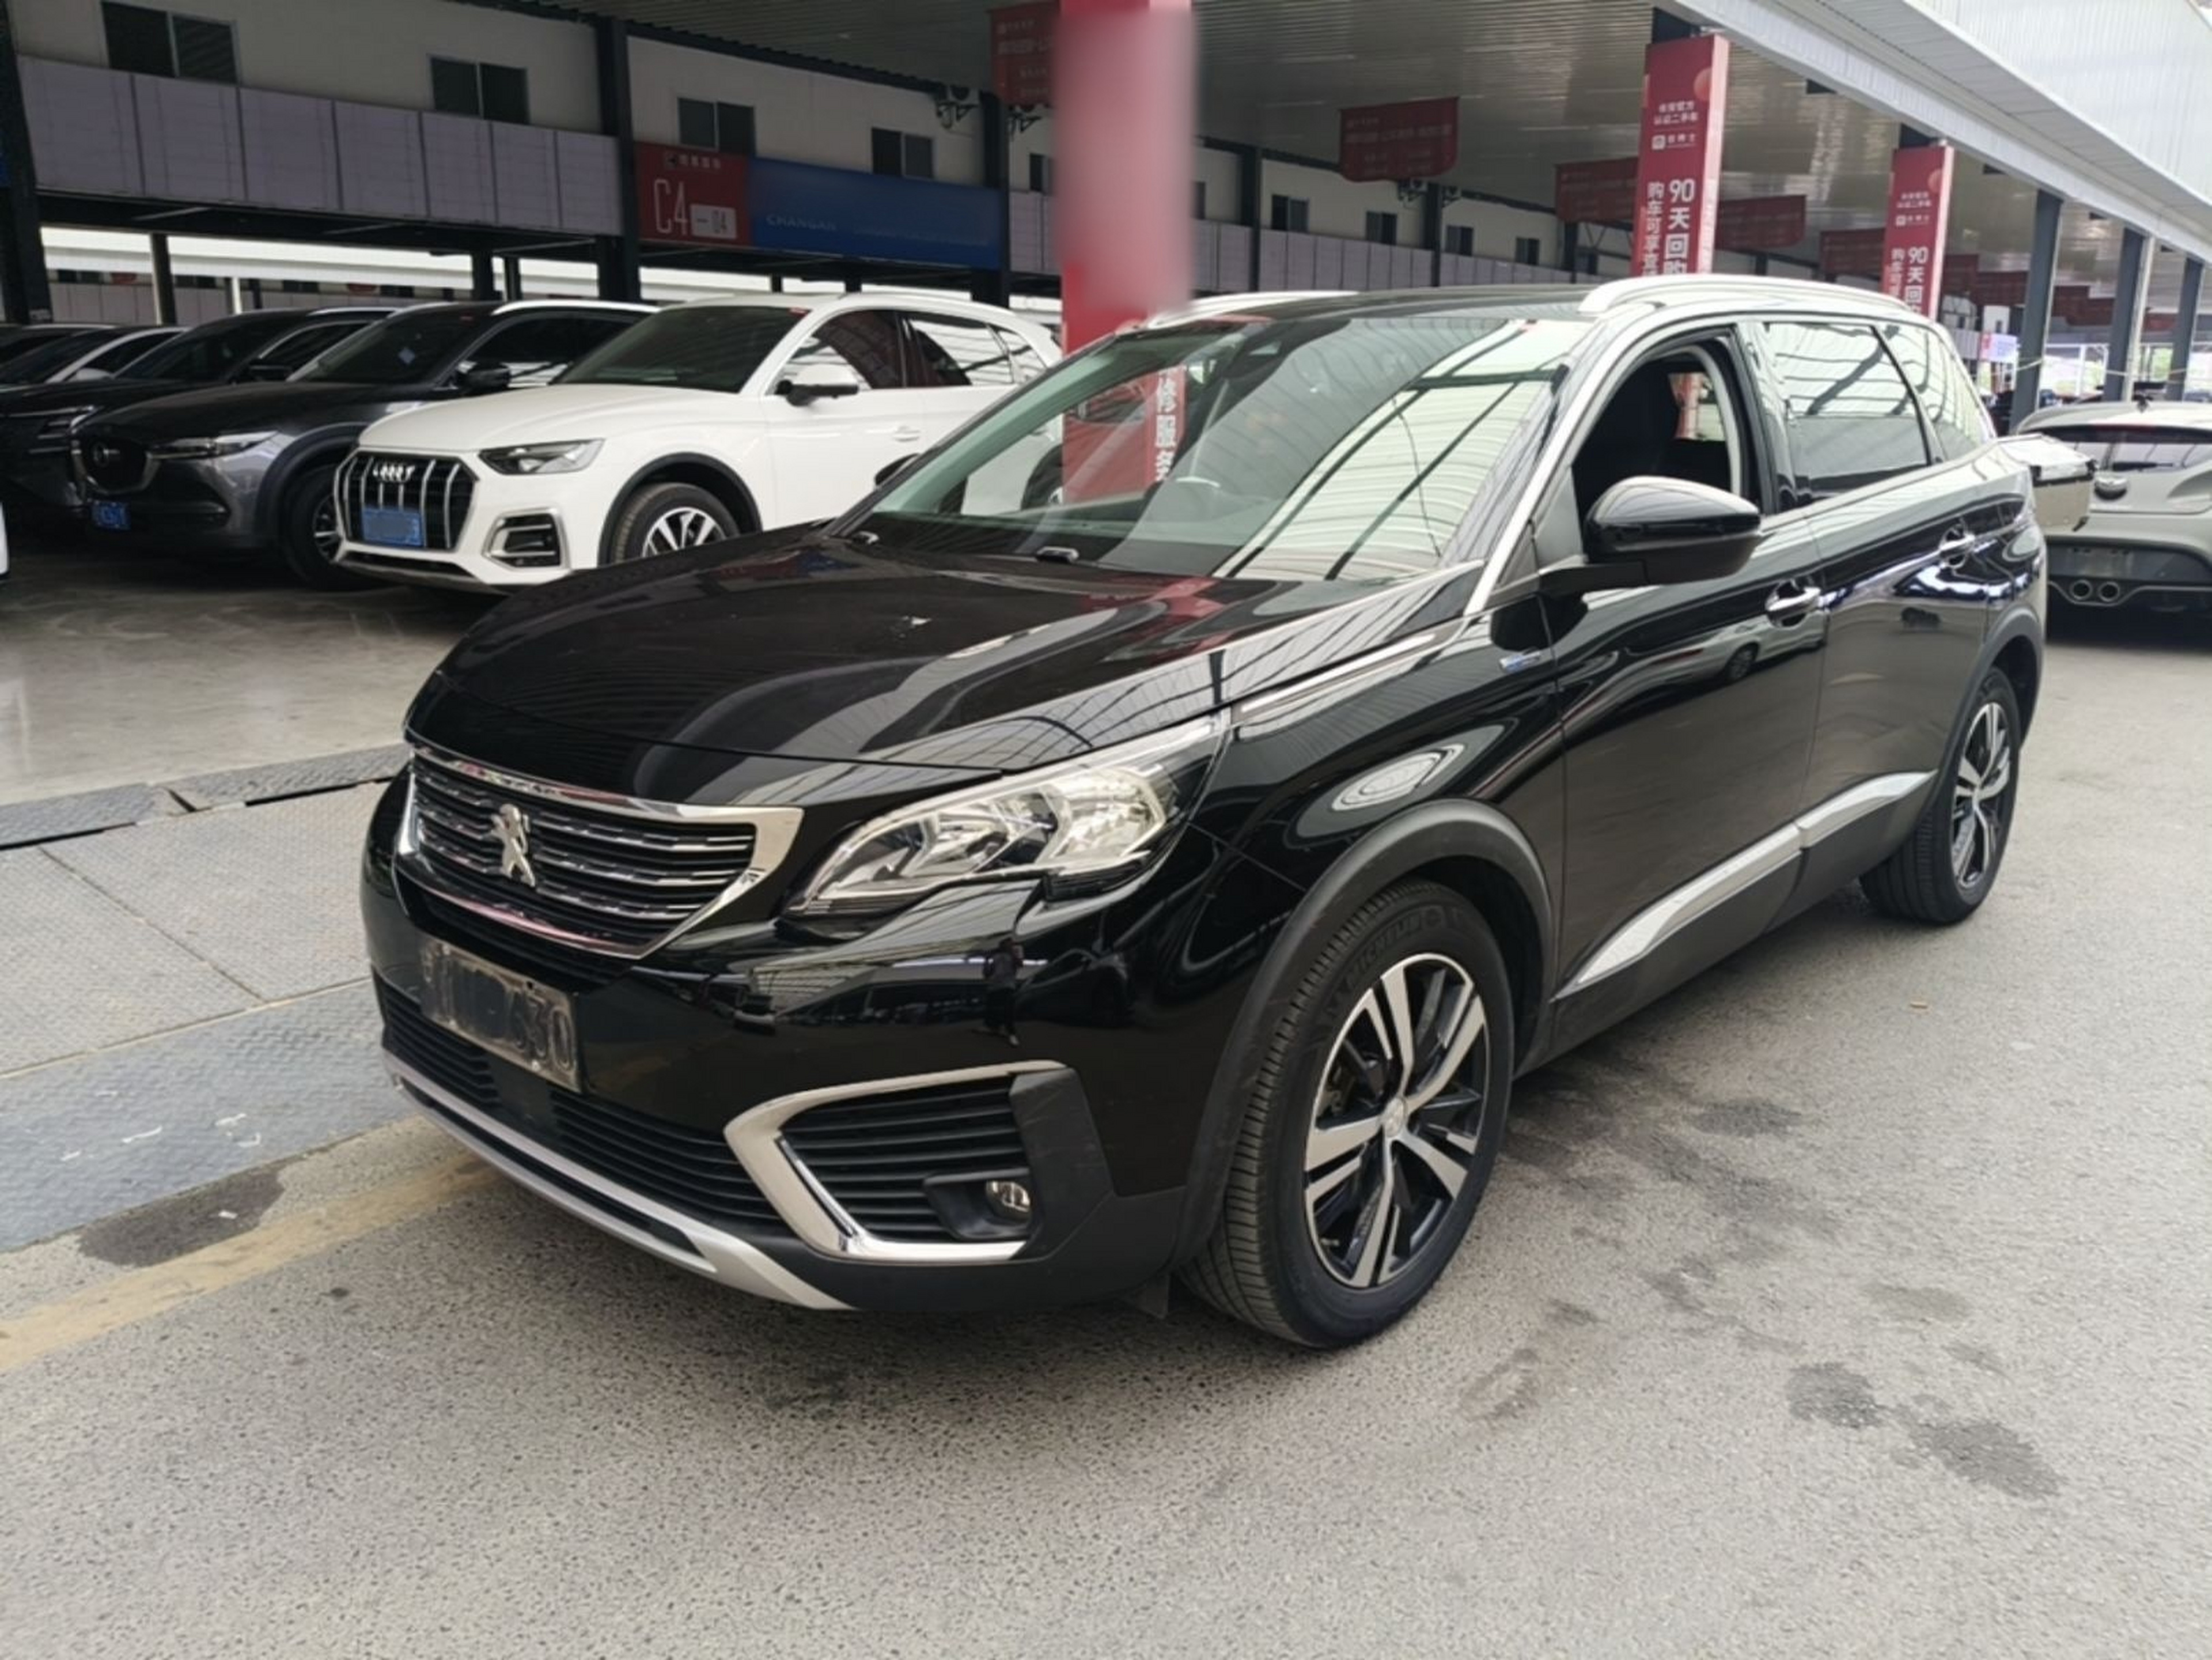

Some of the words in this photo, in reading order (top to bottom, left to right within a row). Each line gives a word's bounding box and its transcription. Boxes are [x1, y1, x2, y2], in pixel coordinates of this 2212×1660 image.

[654, 178, 687, 235] C4
[1904, 246, 1929, 313] 90天回
[1155, 369, 1176, 481] 修服务
